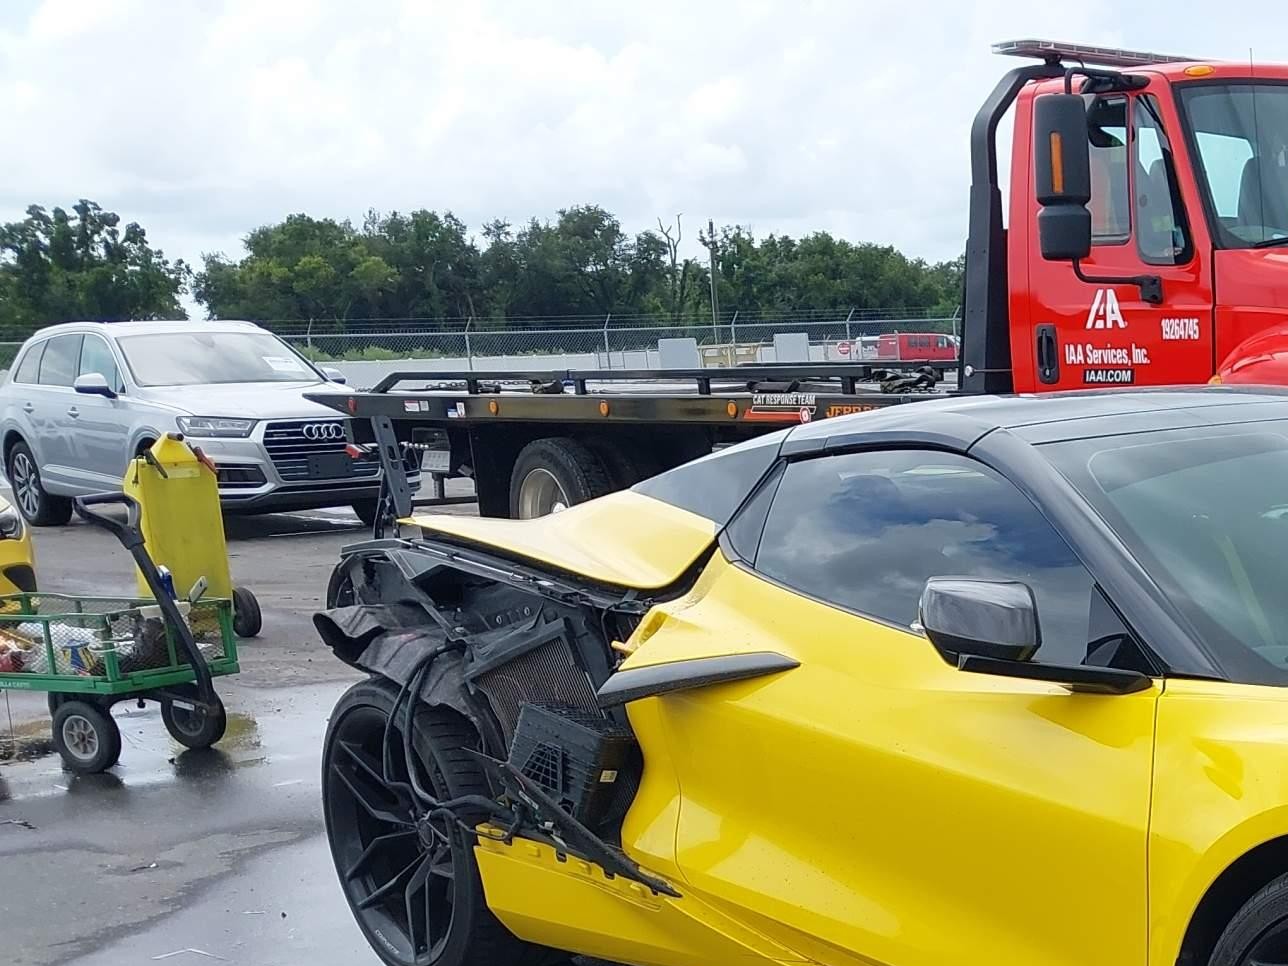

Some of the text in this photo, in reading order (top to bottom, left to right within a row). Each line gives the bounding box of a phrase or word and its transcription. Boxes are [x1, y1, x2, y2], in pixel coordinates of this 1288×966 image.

[1161, 318, 1199, 340] 19264745
[1065, 343, 1151, 366] IAA Services, Inc.
[1086, 370, 1131, 382] IAAI.COM
[752, 394, 815, 405] CAT RESPONSE TEAM
